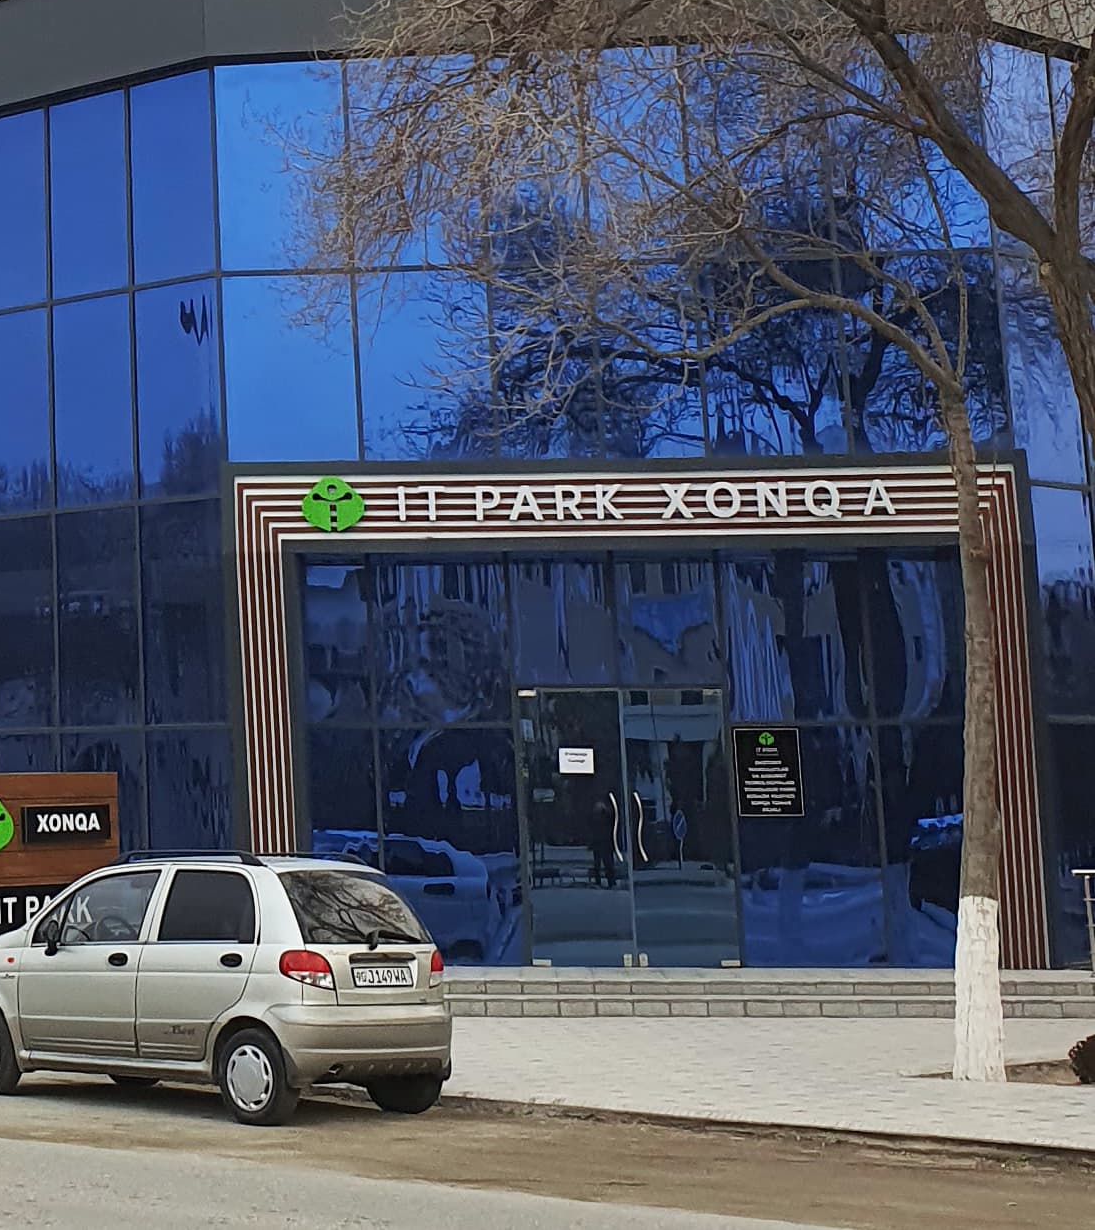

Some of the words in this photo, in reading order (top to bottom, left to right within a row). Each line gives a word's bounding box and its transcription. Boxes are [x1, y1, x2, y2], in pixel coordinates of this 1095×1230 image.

[396, 485, 445, 521] IT
[475, 484, 624, 521] PARK
[660, 479, 896, 519] XONQA
[36, 812, 101, 833] XONQA
